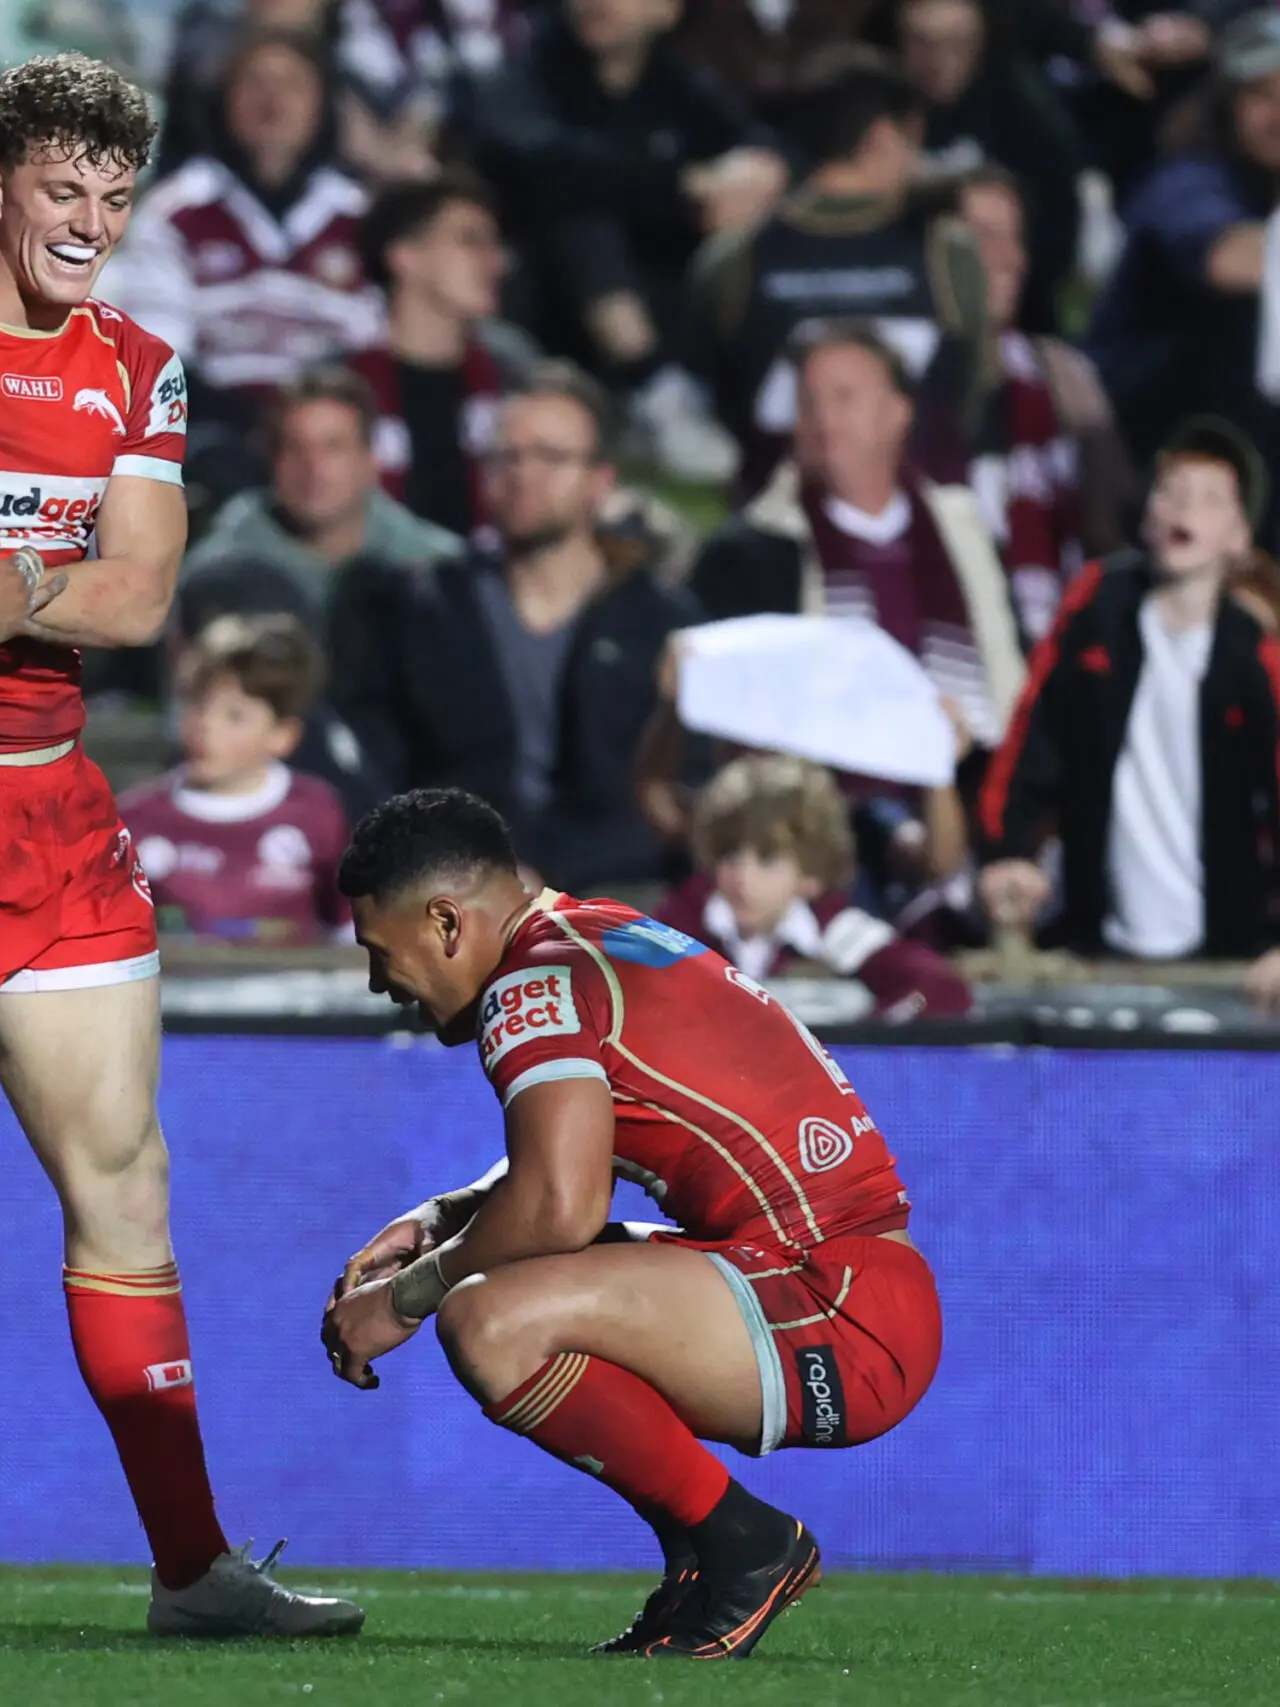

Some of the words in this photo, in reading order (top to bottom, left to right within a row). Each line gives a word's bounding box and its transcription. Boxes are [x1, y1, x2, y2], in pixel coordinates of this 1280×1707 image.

[4, 378, 59, 398] WAHL
[484, 974, 562, 1024] dget
[805, 1352, 841, 1444] rapidline
